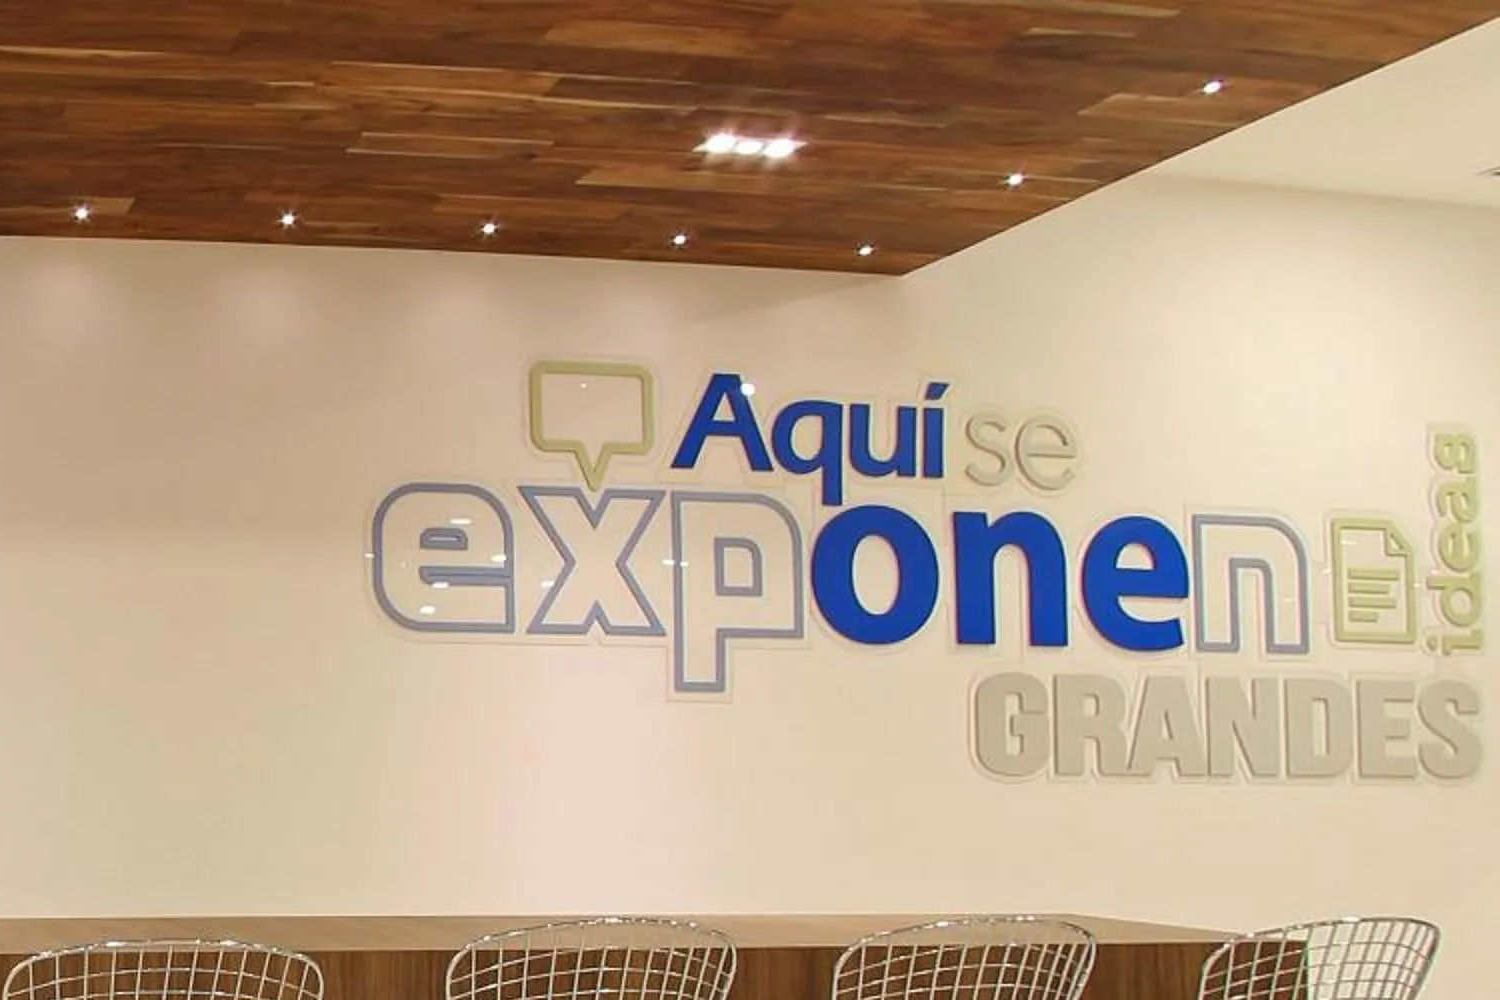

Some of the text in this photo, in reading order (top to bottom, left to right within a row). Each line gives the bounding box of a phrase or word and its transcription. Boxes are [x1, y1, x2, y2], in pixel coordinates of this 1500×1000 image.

[669, 371, 1079, 506] Aquí se
[371, 481, 1311, 695] exponen
[1422, 432, 1484, 656] ideas
[972, 674, 1485, 781] GRANDES
